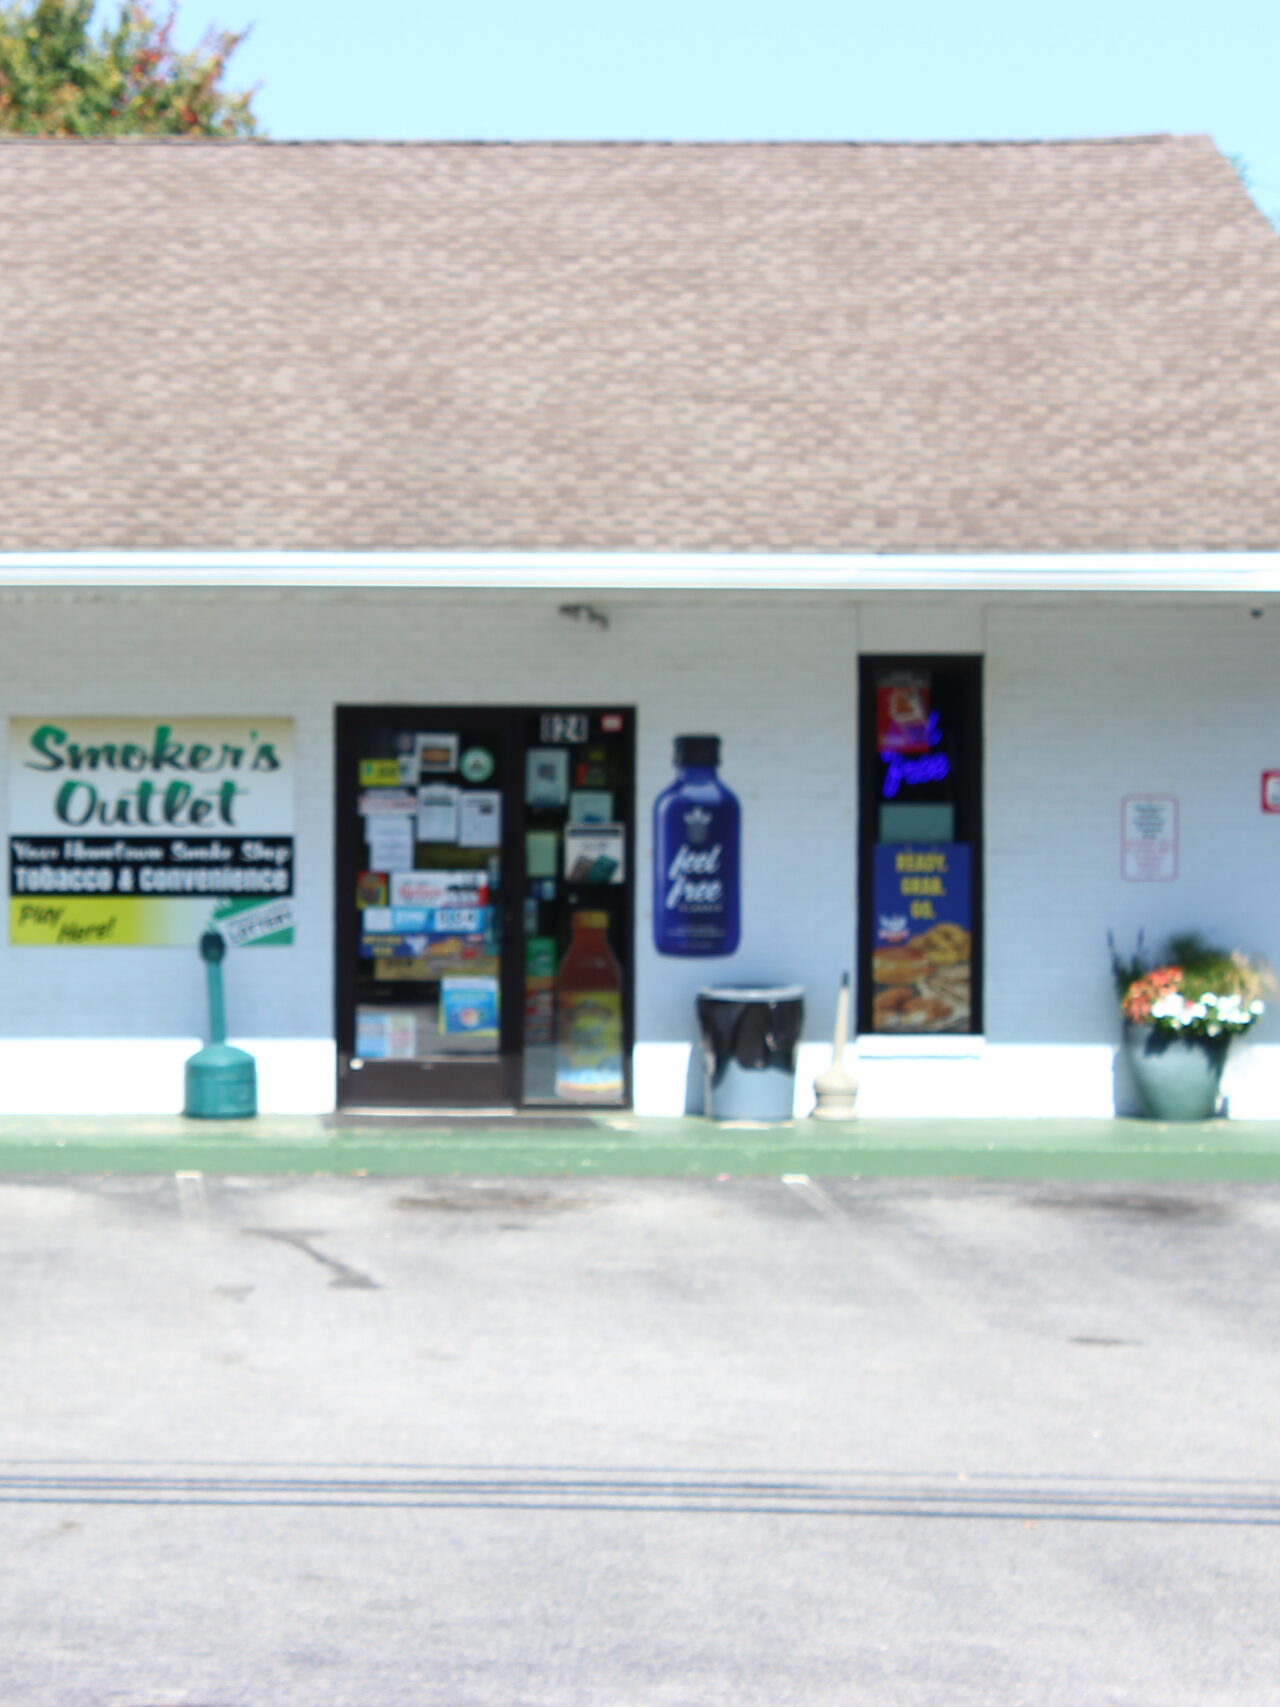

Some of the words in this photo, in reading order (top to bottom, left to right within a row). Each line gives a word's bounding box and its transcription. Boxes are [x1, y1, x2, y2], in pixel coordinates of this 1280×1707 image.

[22, 725, 282, 772] Smoker's
[54, 780, 251, 827] Outlet
[168, 840, 234, 862] Smoke
[239, 840, 291, 865] Shop
[668, 843, 721, 880] feel
[14, 866, 114, 892] Tobacco
[117, 867, 135, 892] &
[138, 865, 290, 892] Convenience
[666, 874, 723, 910] free
